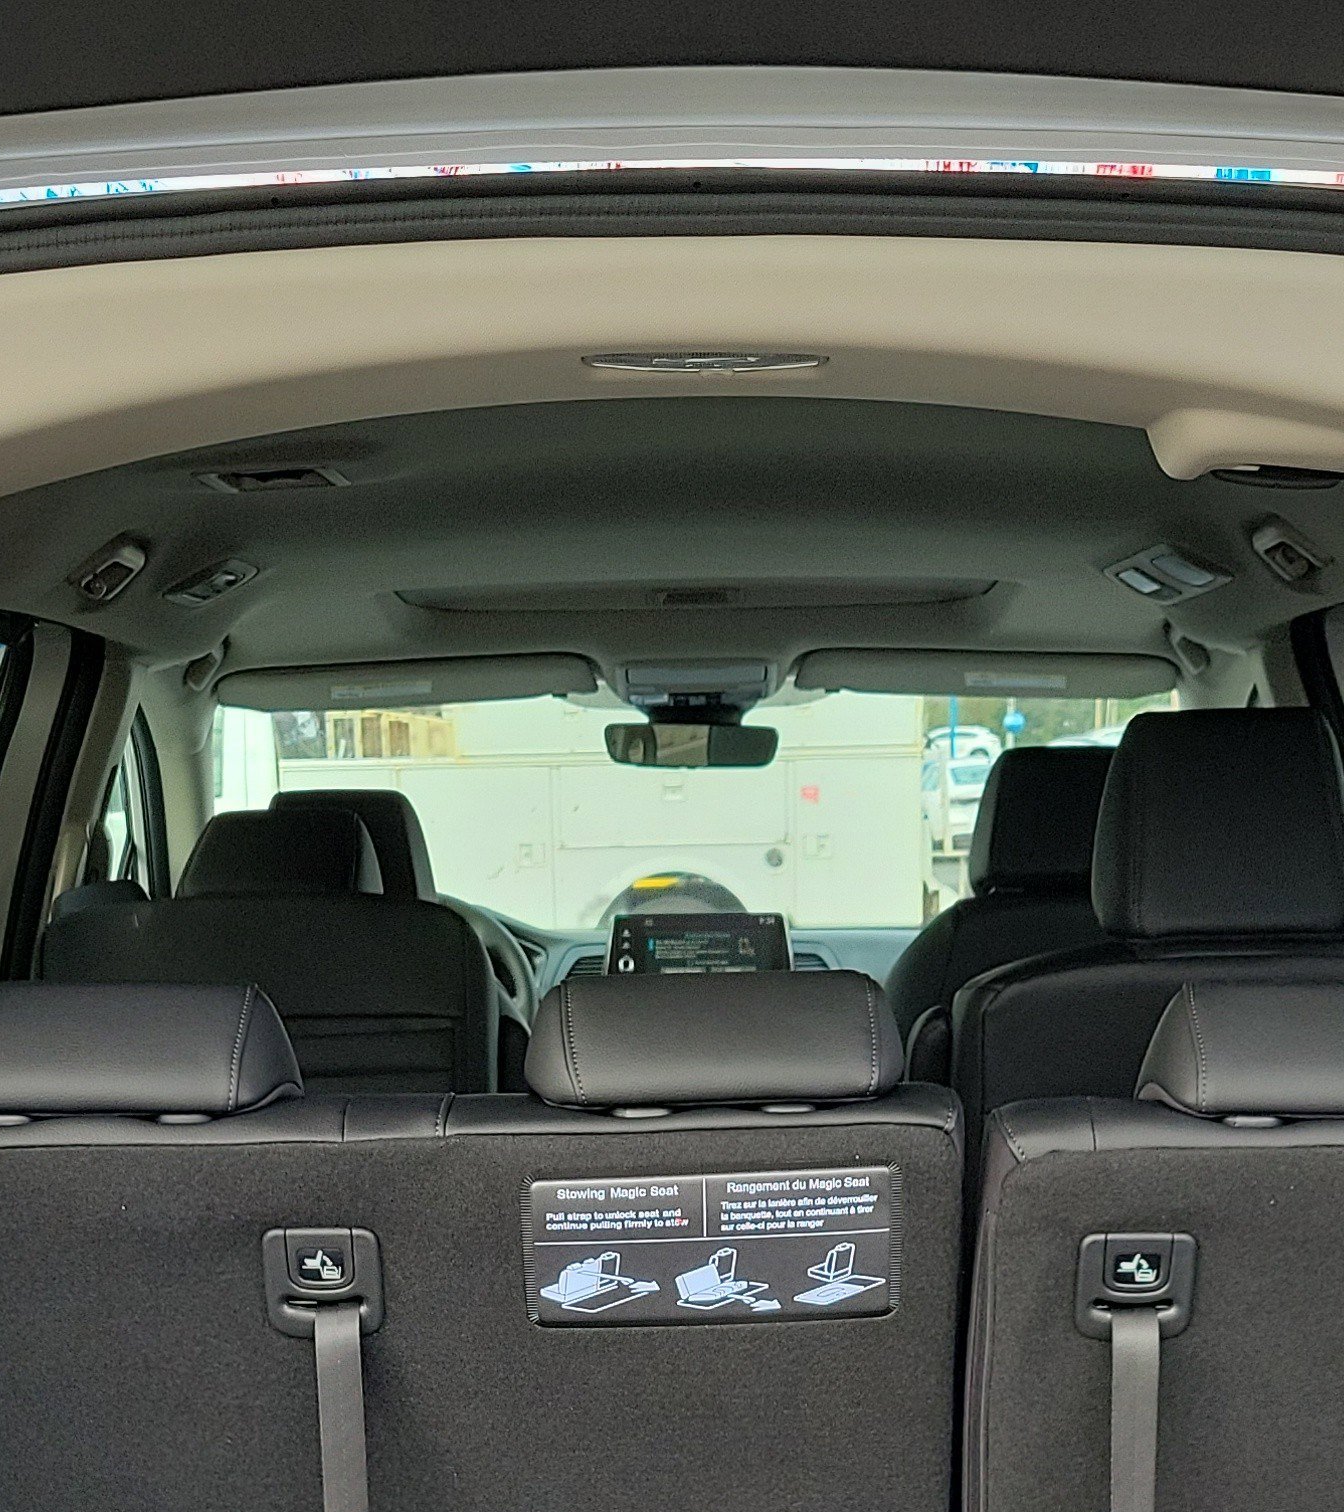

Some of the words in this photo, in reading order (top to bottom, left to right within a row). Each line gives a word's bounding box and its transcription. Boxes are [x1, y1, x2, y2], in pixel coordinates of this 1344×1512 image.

[556, 1187, 606, 1201] Stowing
[610, 1185, 647, 1199] Magic
[650, 1184, 679, 1197] Seat
[726, 1180, 790, 1194] Rangement
[792, 1179, 806, 1190] du
[809, 1177, 842, 1191] Magic
[844, 1176, 870, 1188] Seat
[721, 1200, 742, 1210] Tirez
[743, 1201, 757, 1210] sur
[758, 1199, 766, 1208] la
[798, 1196, 813, 1207] afin
[815, 1195, 826, 1206] de
[546, 1212, 565, 1221] Pull
[567, 1211, 592, 1223] strap
[594, 1211, 604, 1220] to
[605, 1209, 636, 1219] unlock
[638, 1208, 660, 1218] seat
[662, 1207, 681, 1217] and
[721, 1211, 729, 1221] la
[775, 1208, 792, 1218] tout
[793, 1209, 805, 1217] en
[806, 1206, 848, 1217] continuant
[857, 1204, 874, 1214] tirer
[546, 1220, 588, 1231] continue
[590, 1219, 623, 1231] pulling
[624, 1218, 653, 1230] firmly
[654, 1218, 664, 1227] to
[665, 1217, 689, 1227] stow
[721, 1223, 734, 1231] sur
[767, 1220, 786, 1231] pour
[787, 1219, 795, 1229] la
[796, 1218, 824, 1230] ranger
